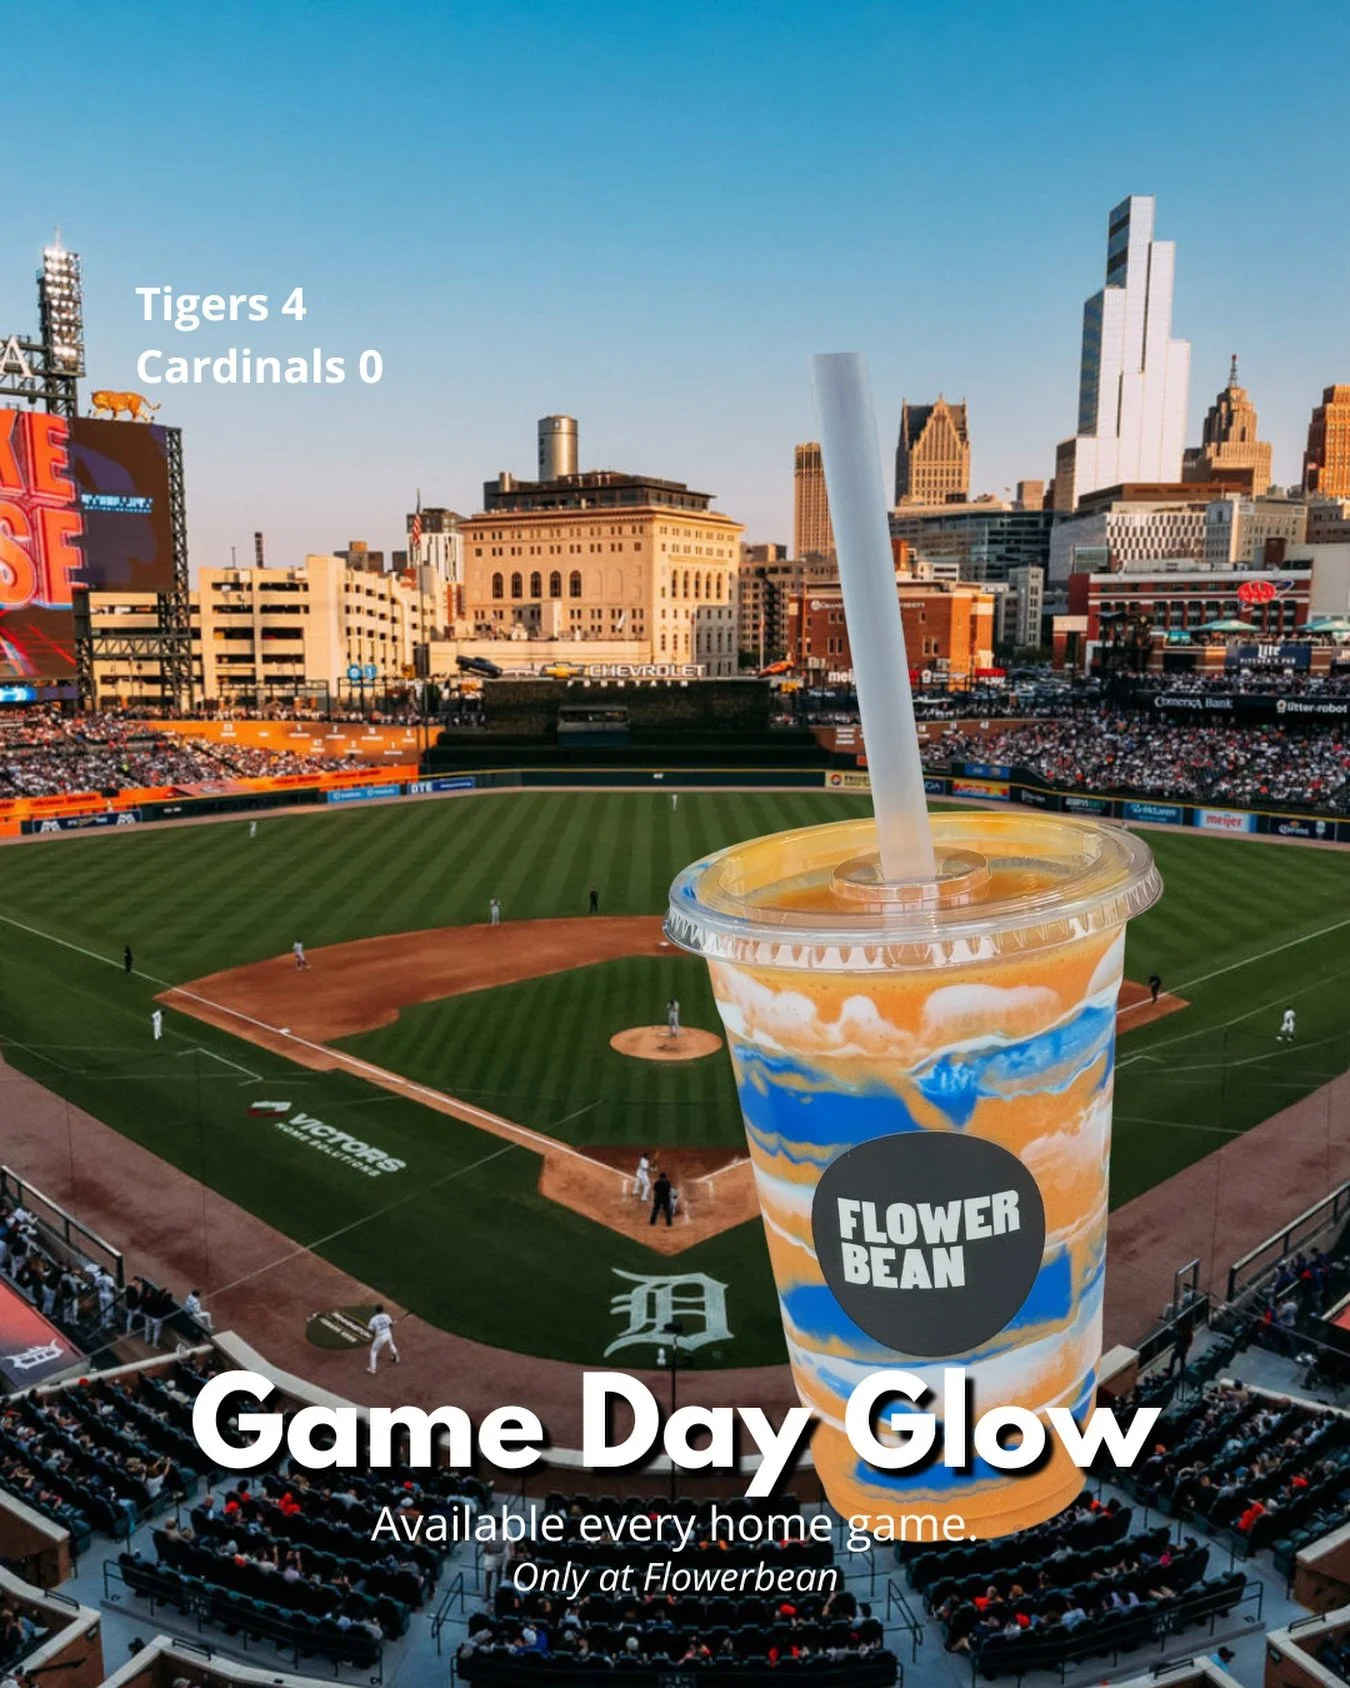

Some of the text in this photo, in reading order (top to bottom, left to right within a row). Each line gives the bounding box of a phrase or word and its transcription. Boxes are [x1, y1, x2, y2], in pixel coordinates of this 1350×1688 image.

[589, 664, 706, 678] CHEVROLET
[566, 680, 689, 688] FOUNTAIN
[1205, 698, 1233, 709] Bank
[1287, 701, 1348, 714] litter-robot
[411, 781, 433, 794] DTE
[289, 1112, 407, 1173] VICTORS
[307, 1138, 382, 1178] SOLUTIONS
[837, 1190, 1021, 1246] FLOWER
[841, 1242, 966, 1290] BEAN
